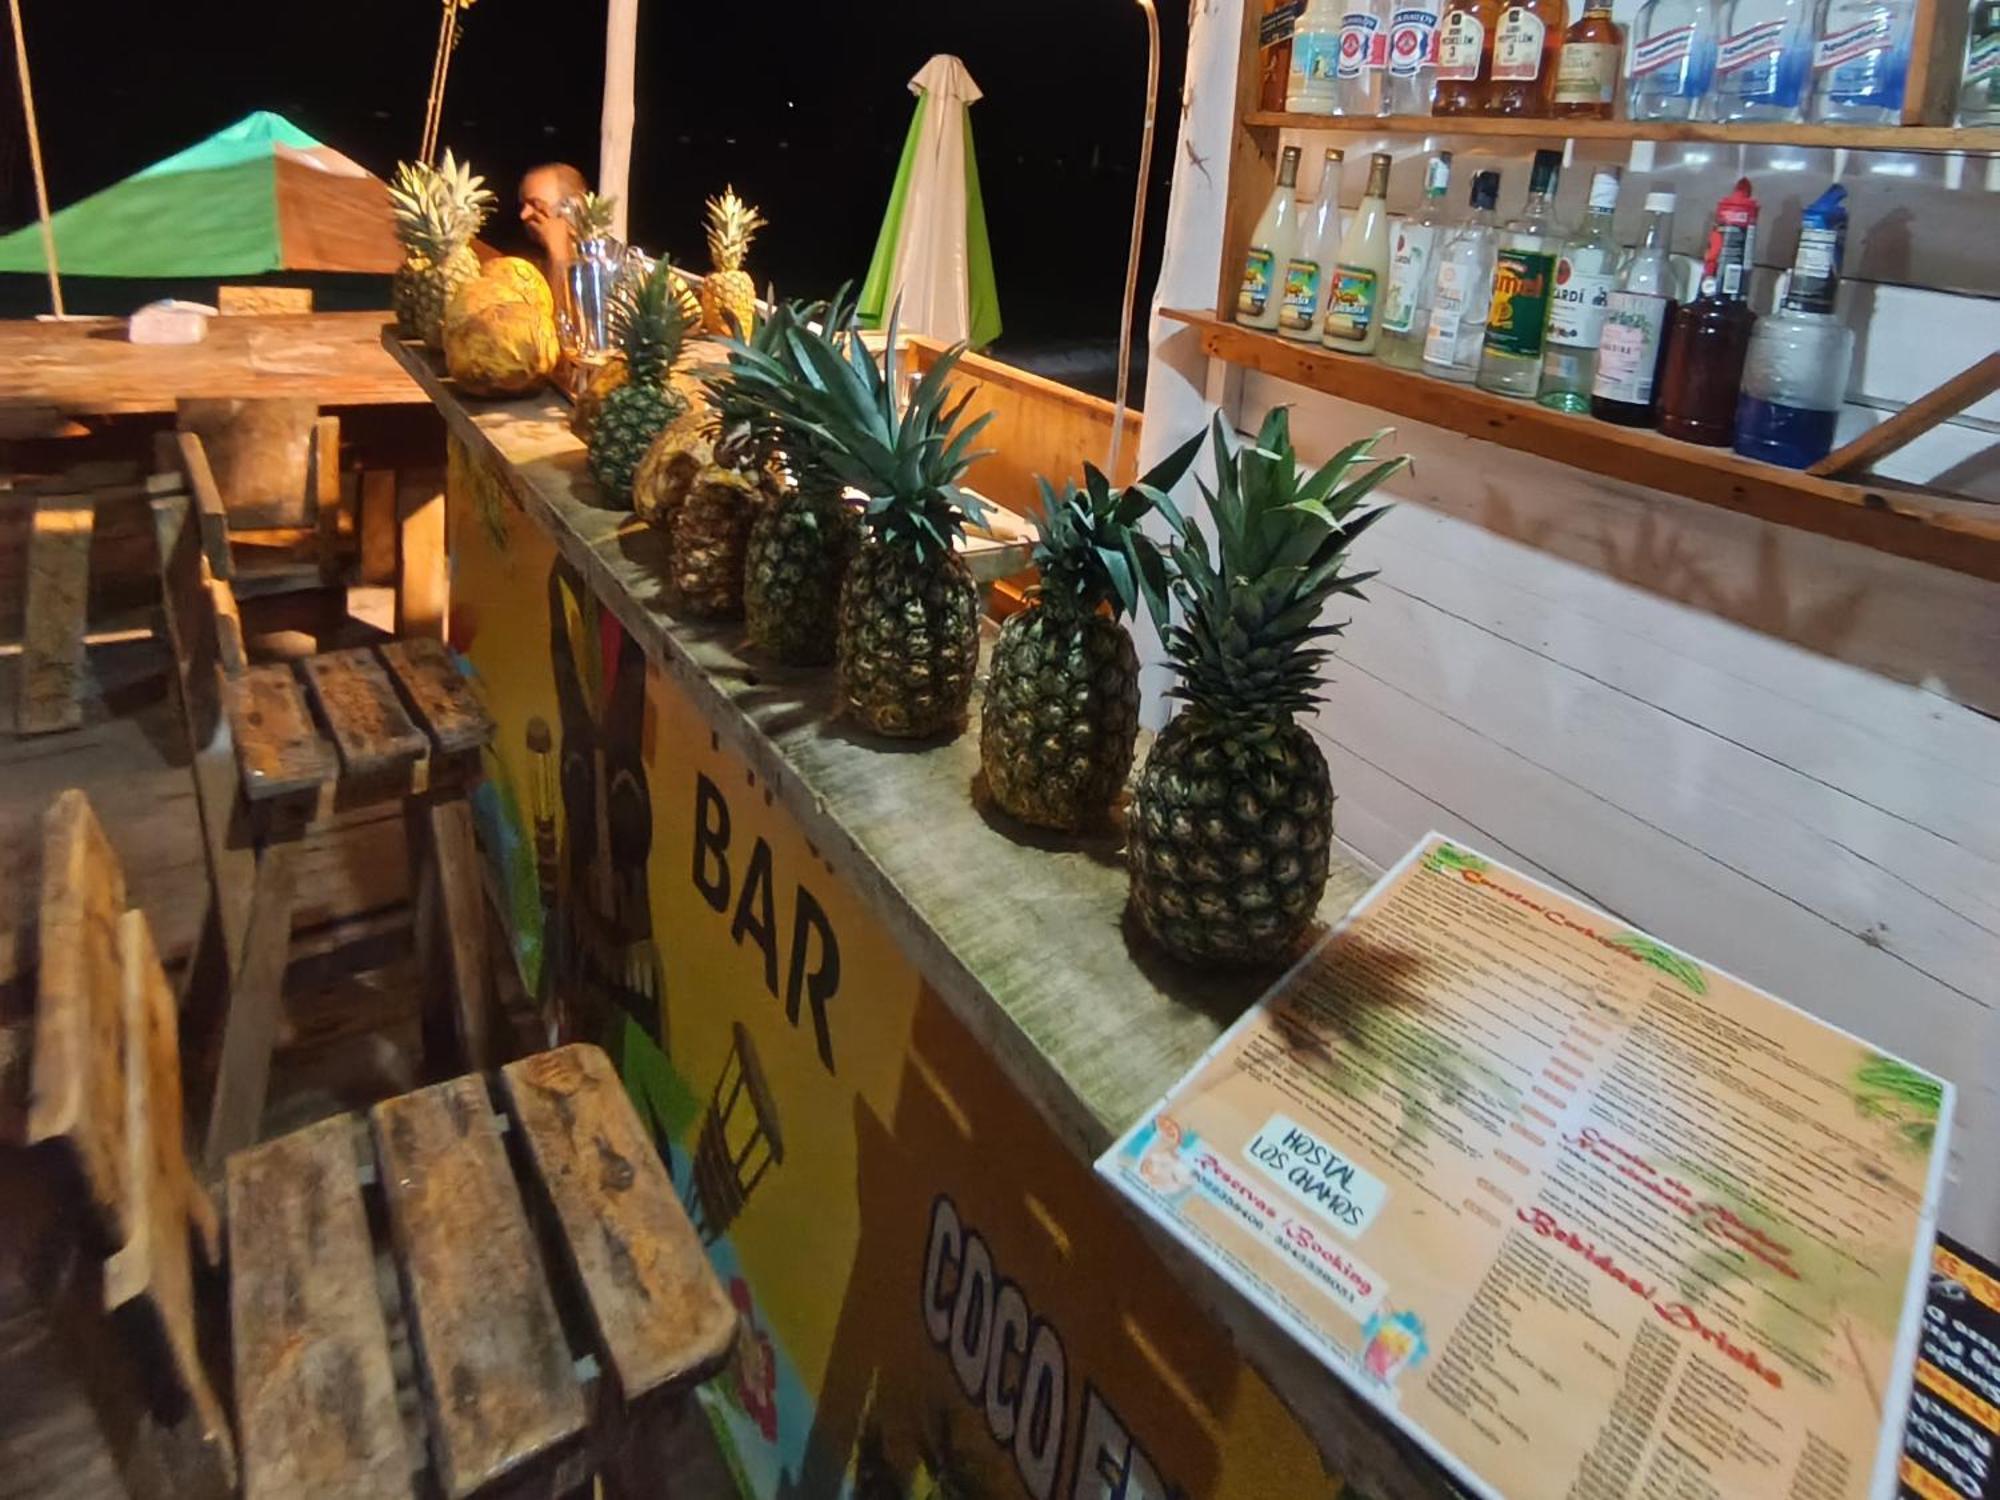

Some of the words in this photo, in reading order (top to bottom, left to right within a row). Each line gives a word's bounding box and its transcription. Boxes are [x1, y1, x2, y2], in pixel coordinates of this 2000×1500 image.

[692, 771, 841, 1077] BAR
[1194, 1153, 1277, 1219] Reservas
[1249, 1135, 1292, 1172] LOS
[1282, 1127, 1357, 1194] HOSTAL
[922, 1193, 1068, 1500] COCO
